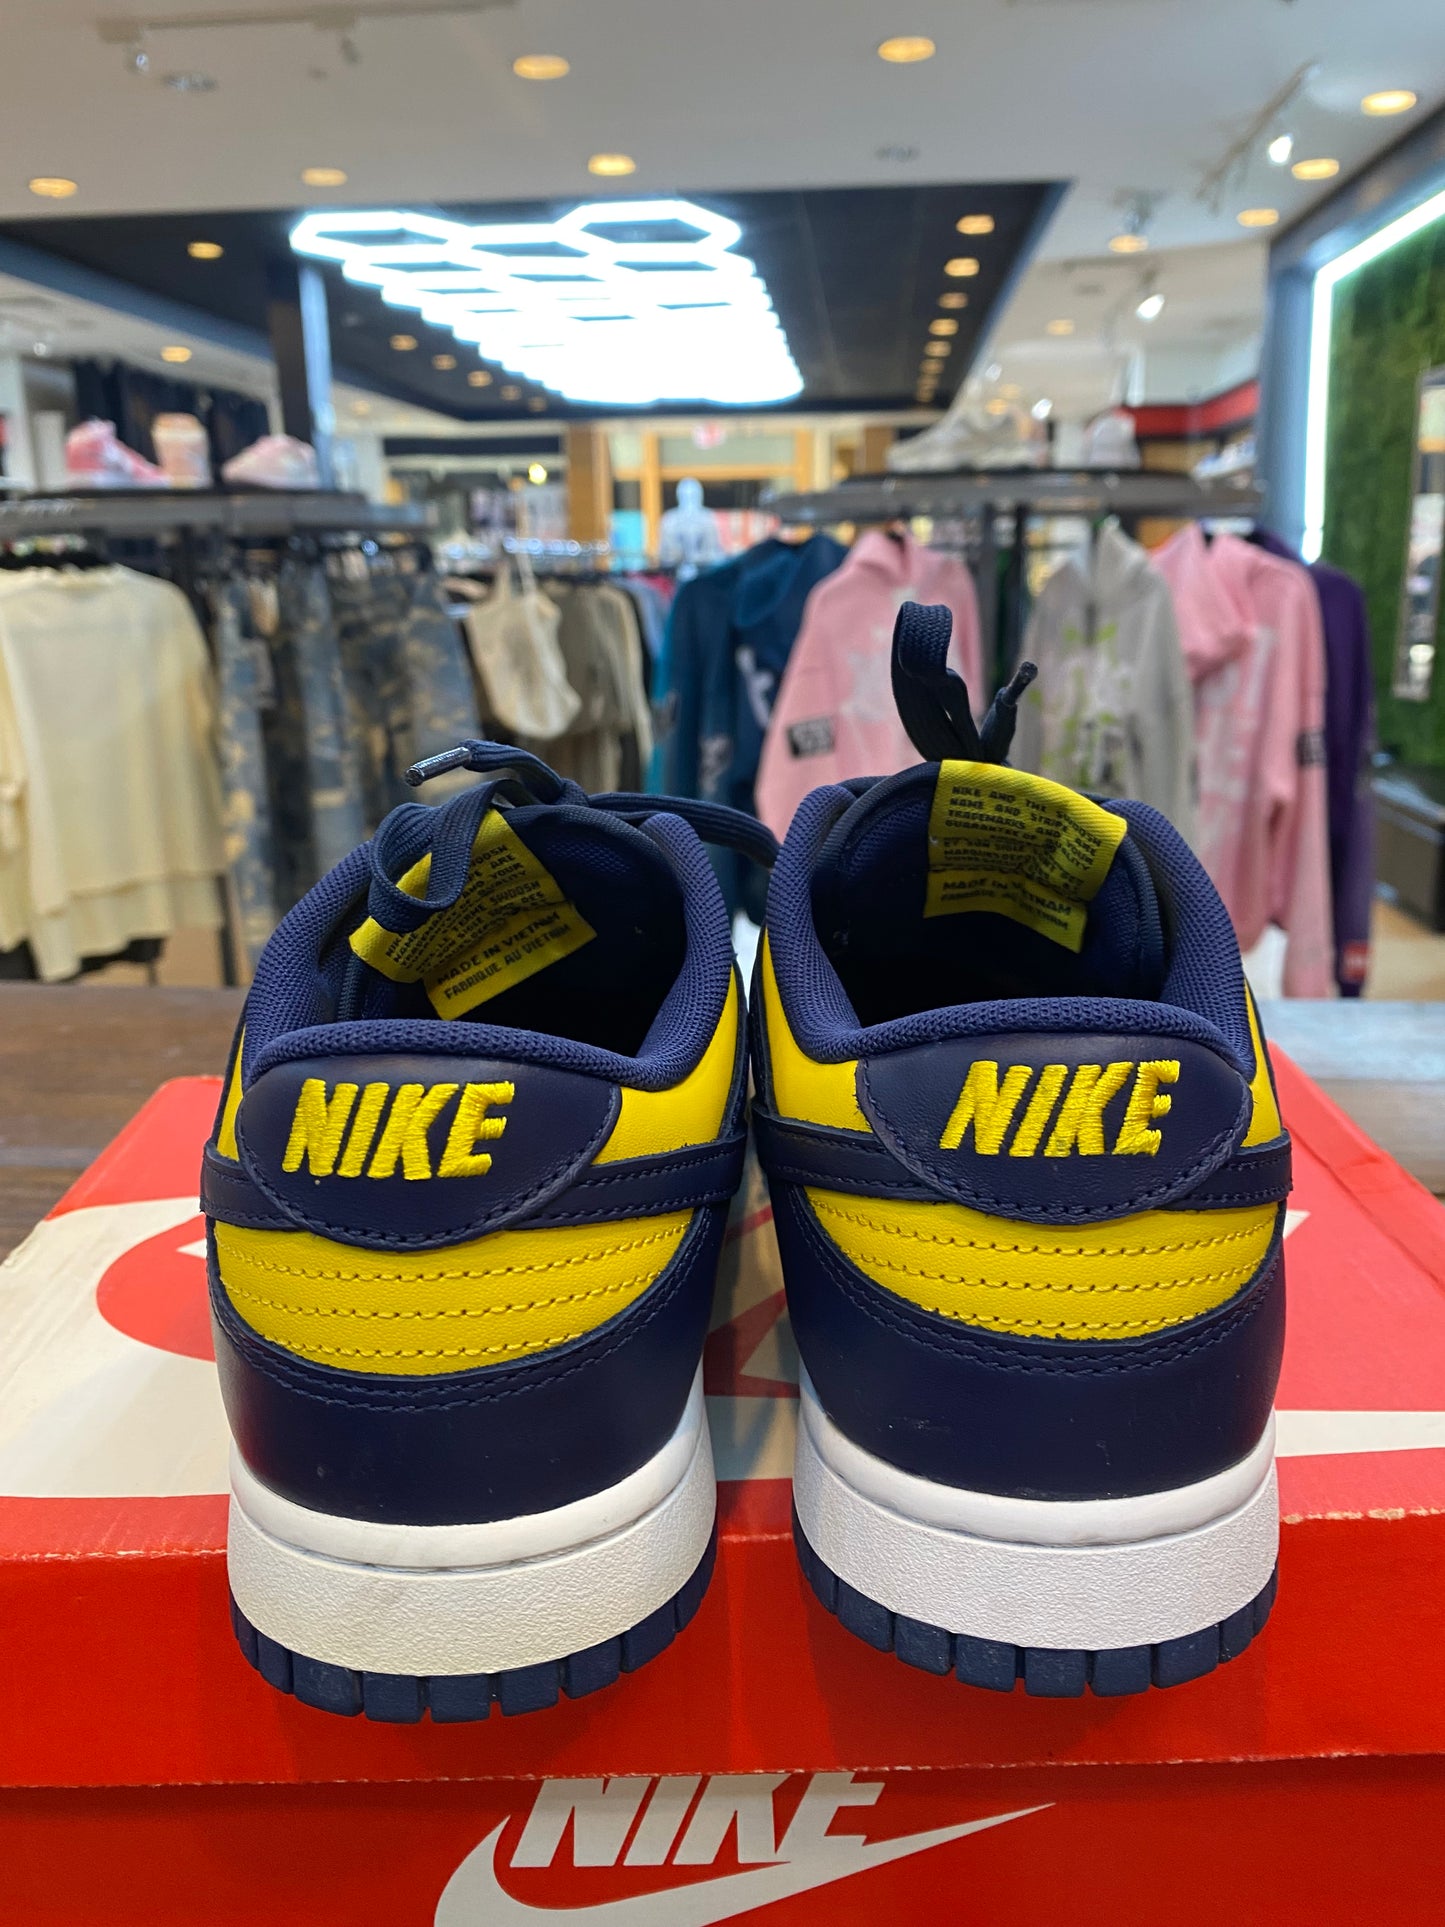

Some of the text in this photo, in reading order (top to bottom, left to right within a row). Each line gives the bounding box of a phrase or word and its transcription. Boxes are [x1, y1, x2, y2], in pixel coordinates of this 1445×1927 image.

[952, 786, 981, 797] NIKE
[989, 791, 1016, 803] AND
[1025, 799, 1046, 812] THE
[948, 810, 1026, 829] TRADEMARKS
[1035, 827, 1061, 838] AND
[1067, 841, 1094, 865] YOUR
[950, 798, 1097, 856] NAME AND STRIPE ARE
[462, 880, 485, 898] AND
[488, 862, 524, 879] YOUR
[489, 880, 541, 905] SWOOSH
[393, 932, 418, 963] NAME
[490, 853, 516, 869] ARE
[385, 934, 407, 957] NIK
[437, 955, 481, 985] MADE
[483, 944, 501, 959] IN
[444, 962, 502, 1000] FABRIQUE
[503, 950, 522, 965] AU
[282, 1078, 515, 1180] NIKE
[939, 1060, 1181, 1157] NIKE
[509, 1771, 886, 1868] NIKE
